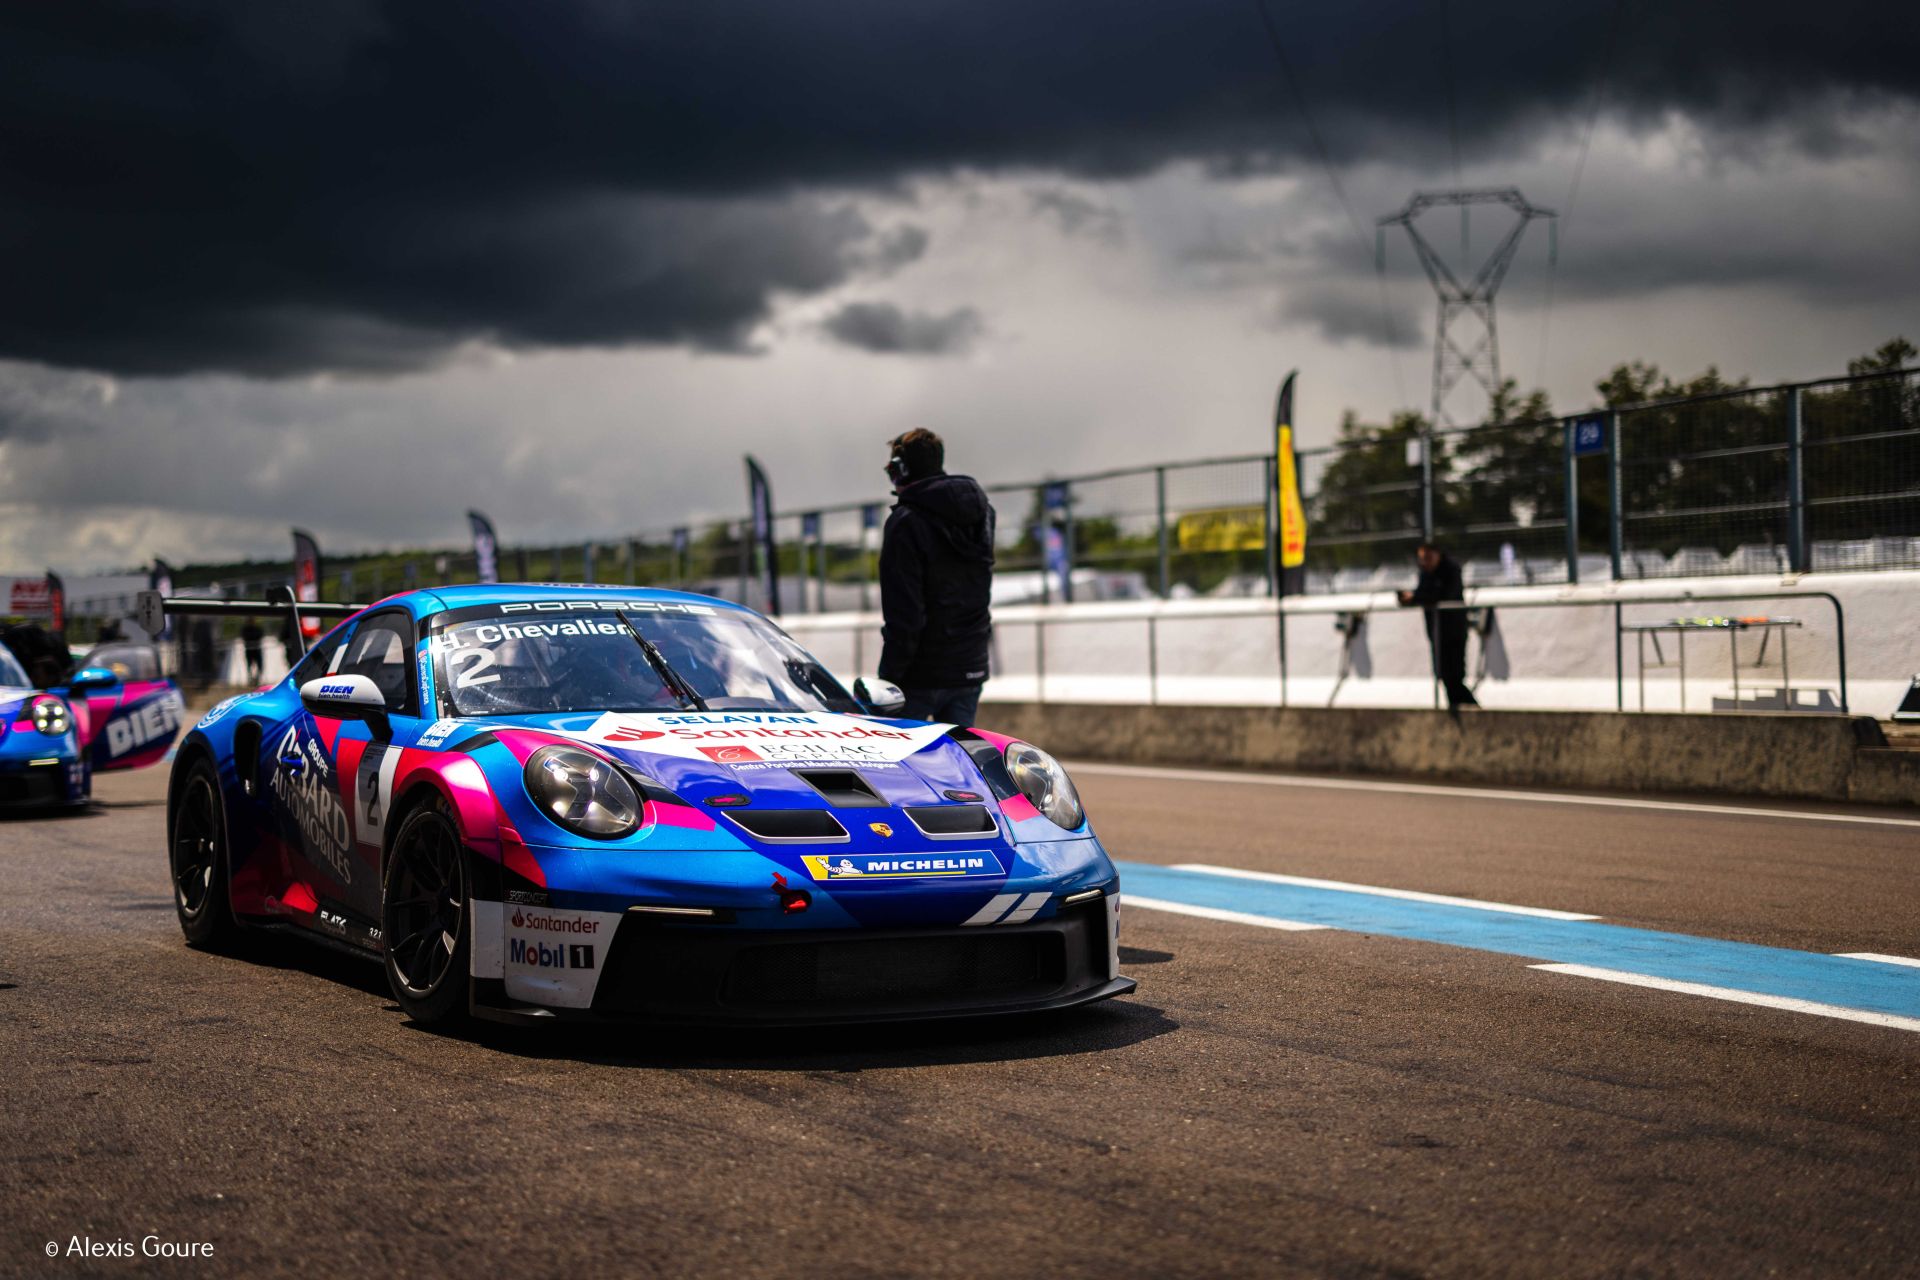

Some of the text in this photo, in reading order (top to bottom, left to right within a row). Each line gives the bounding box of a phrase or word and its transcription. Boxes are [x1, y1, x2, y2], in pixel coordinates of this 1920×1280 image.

[501, 601, 717, 616] PORSCHE
[476, 619, 633, 643] Chevalier
[451, 647, 502, 689] 2
[658, 715, 818, 725] SELAVAN
[669, 727, 913, 741] Santander
[308, 738, 329, 778] GROUPE
[764, 761, 804, 769] Porsche
[367, 772, 380, 827] 2
[270, 767, 351, 884] AUTOMOBILES
[867, 858, 984, 871] MICHELIN
[526, 913, 600, 934] Santander
[510, 938, 565, 968] Mobil
